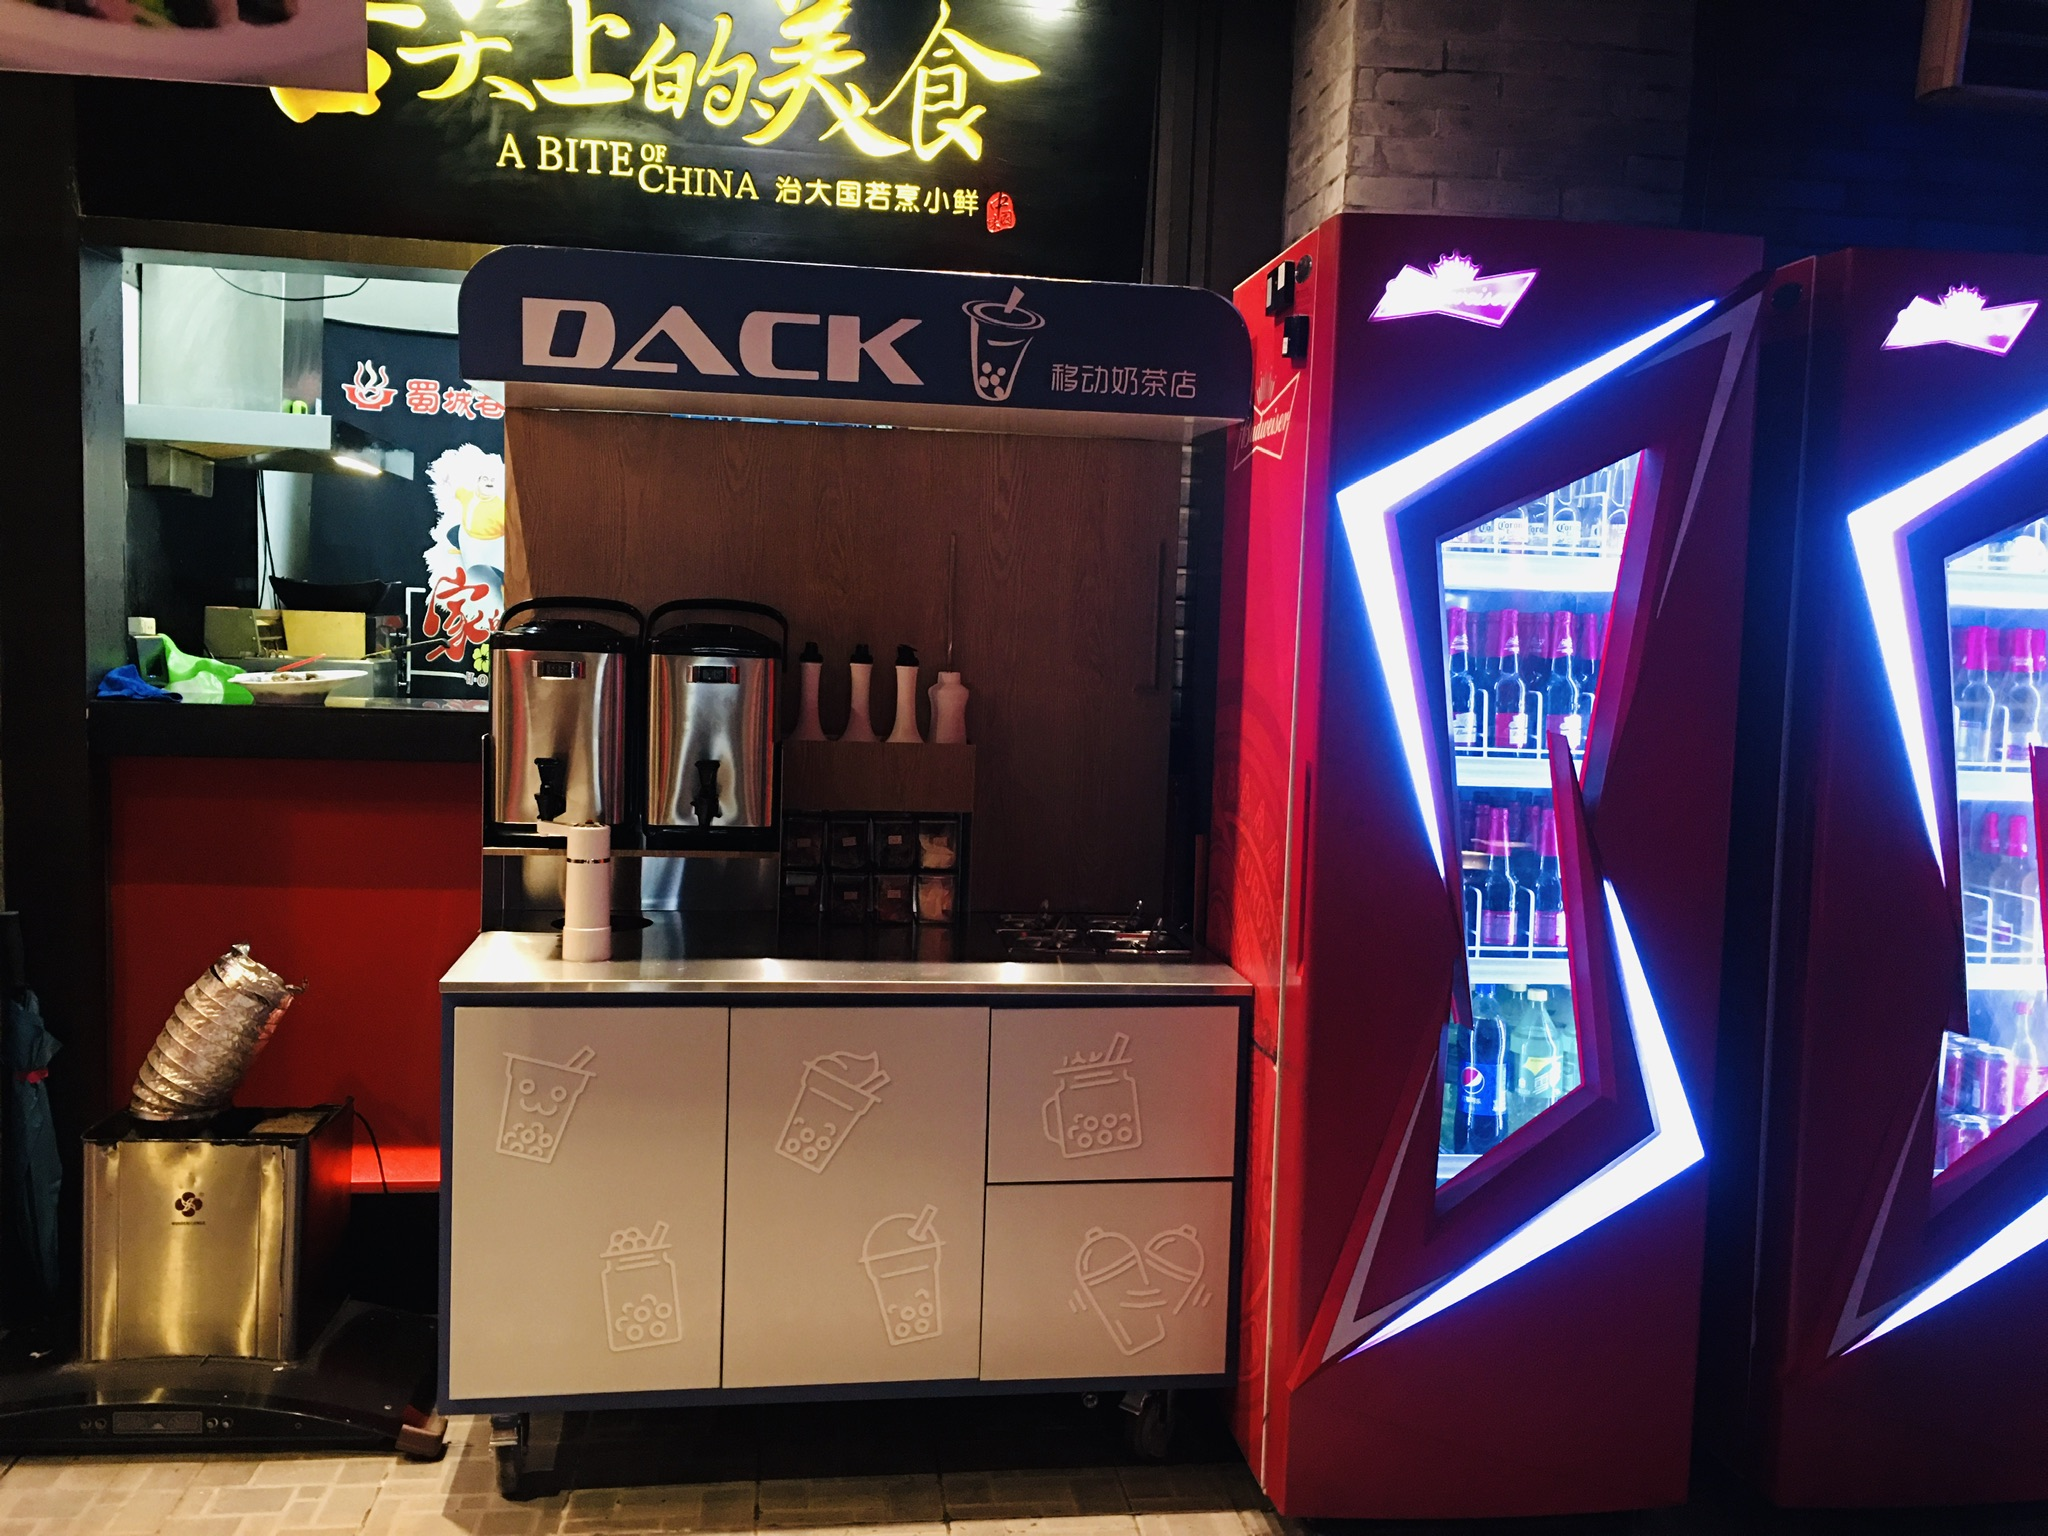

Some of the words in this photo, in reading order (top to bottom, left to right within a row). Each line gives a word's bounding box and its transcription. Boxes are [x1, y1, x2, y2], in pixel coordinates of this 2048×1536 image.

[496, 133, 526, 169] A
[537, 135, 634, 177] BITE
[640, 143, 667, 163] OF
[638, 164, 759, 200] CHINA
[775, 175, 980, 217] 治大国若烹小鲜
[522, 297, 925, 386] DACK
[1051, 363, 1197, 399] 移动奶茶店
